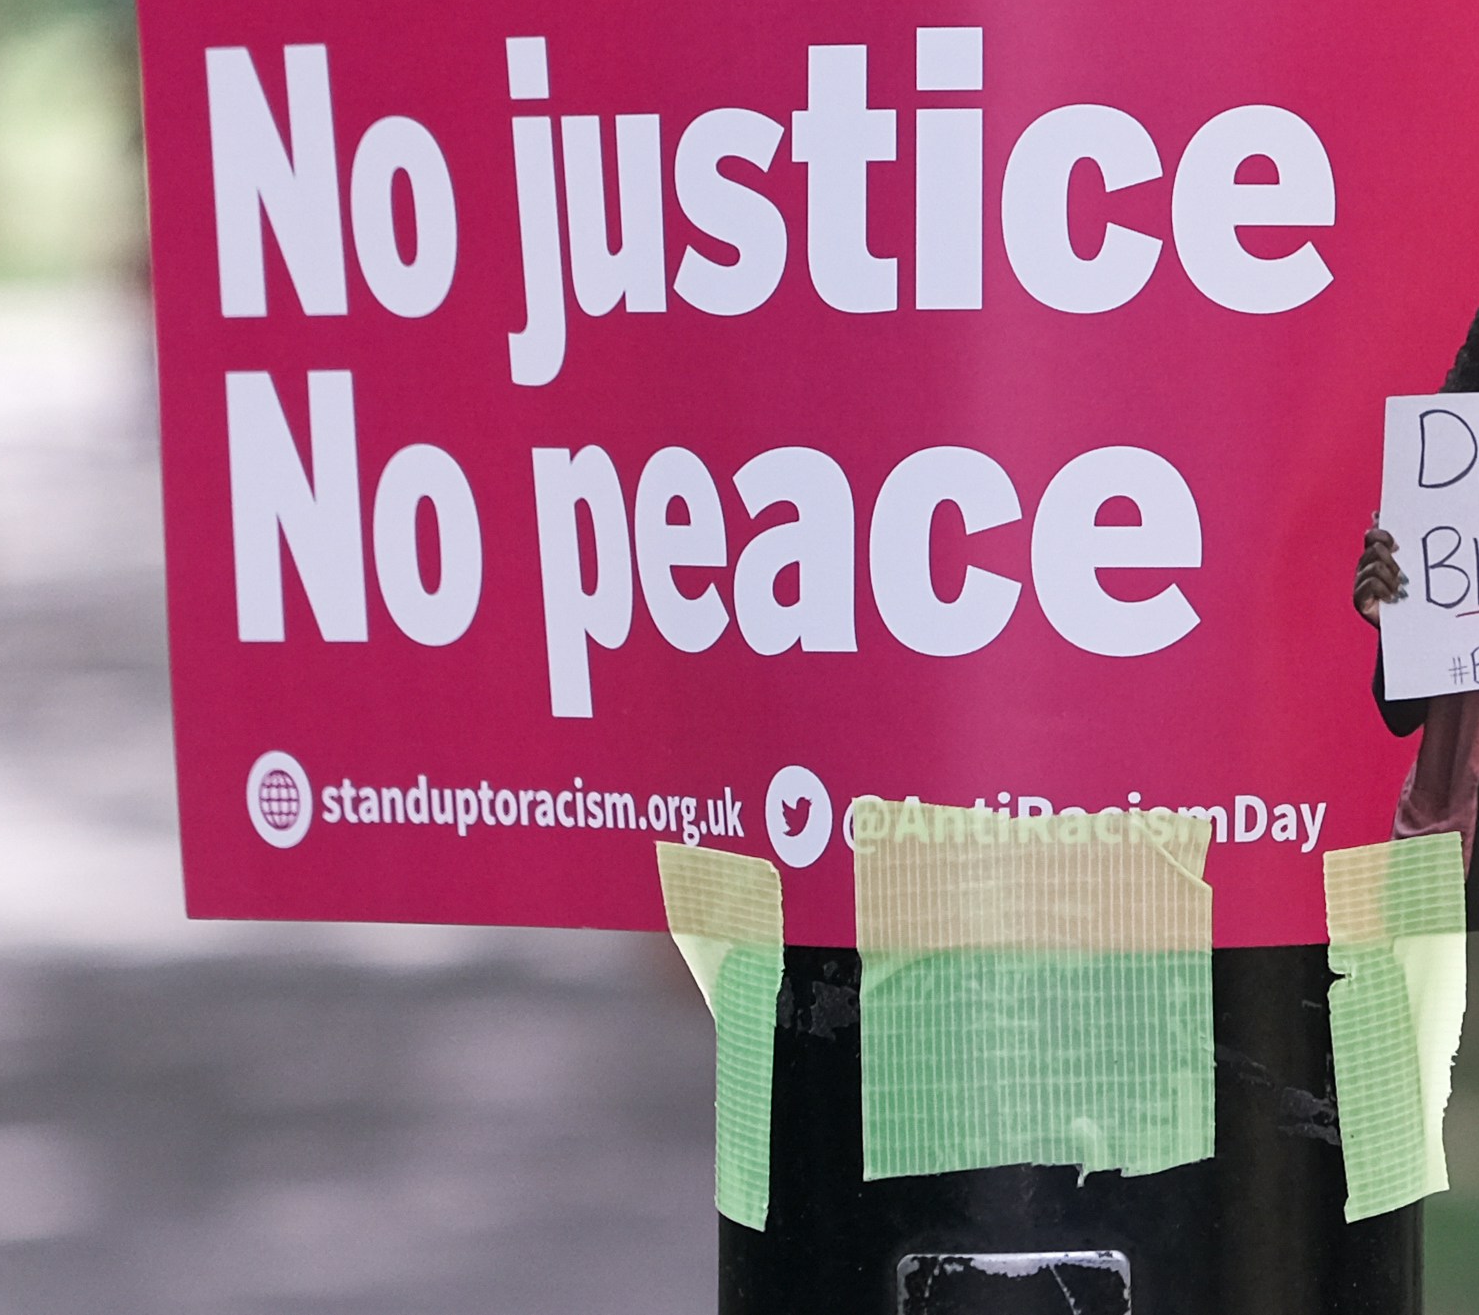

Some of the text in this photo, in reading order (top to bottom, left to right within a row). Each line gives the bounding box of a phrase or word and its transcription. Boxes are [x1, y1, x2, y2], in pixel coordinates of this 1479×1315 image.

[204, 26, 1337, 387] No justice
[226, 370, 1204, 719] No peace
[320, 774, 745, 849] standuptoracism.org.uk
[843, 791, 1328, 855] @AntiRacismDay
